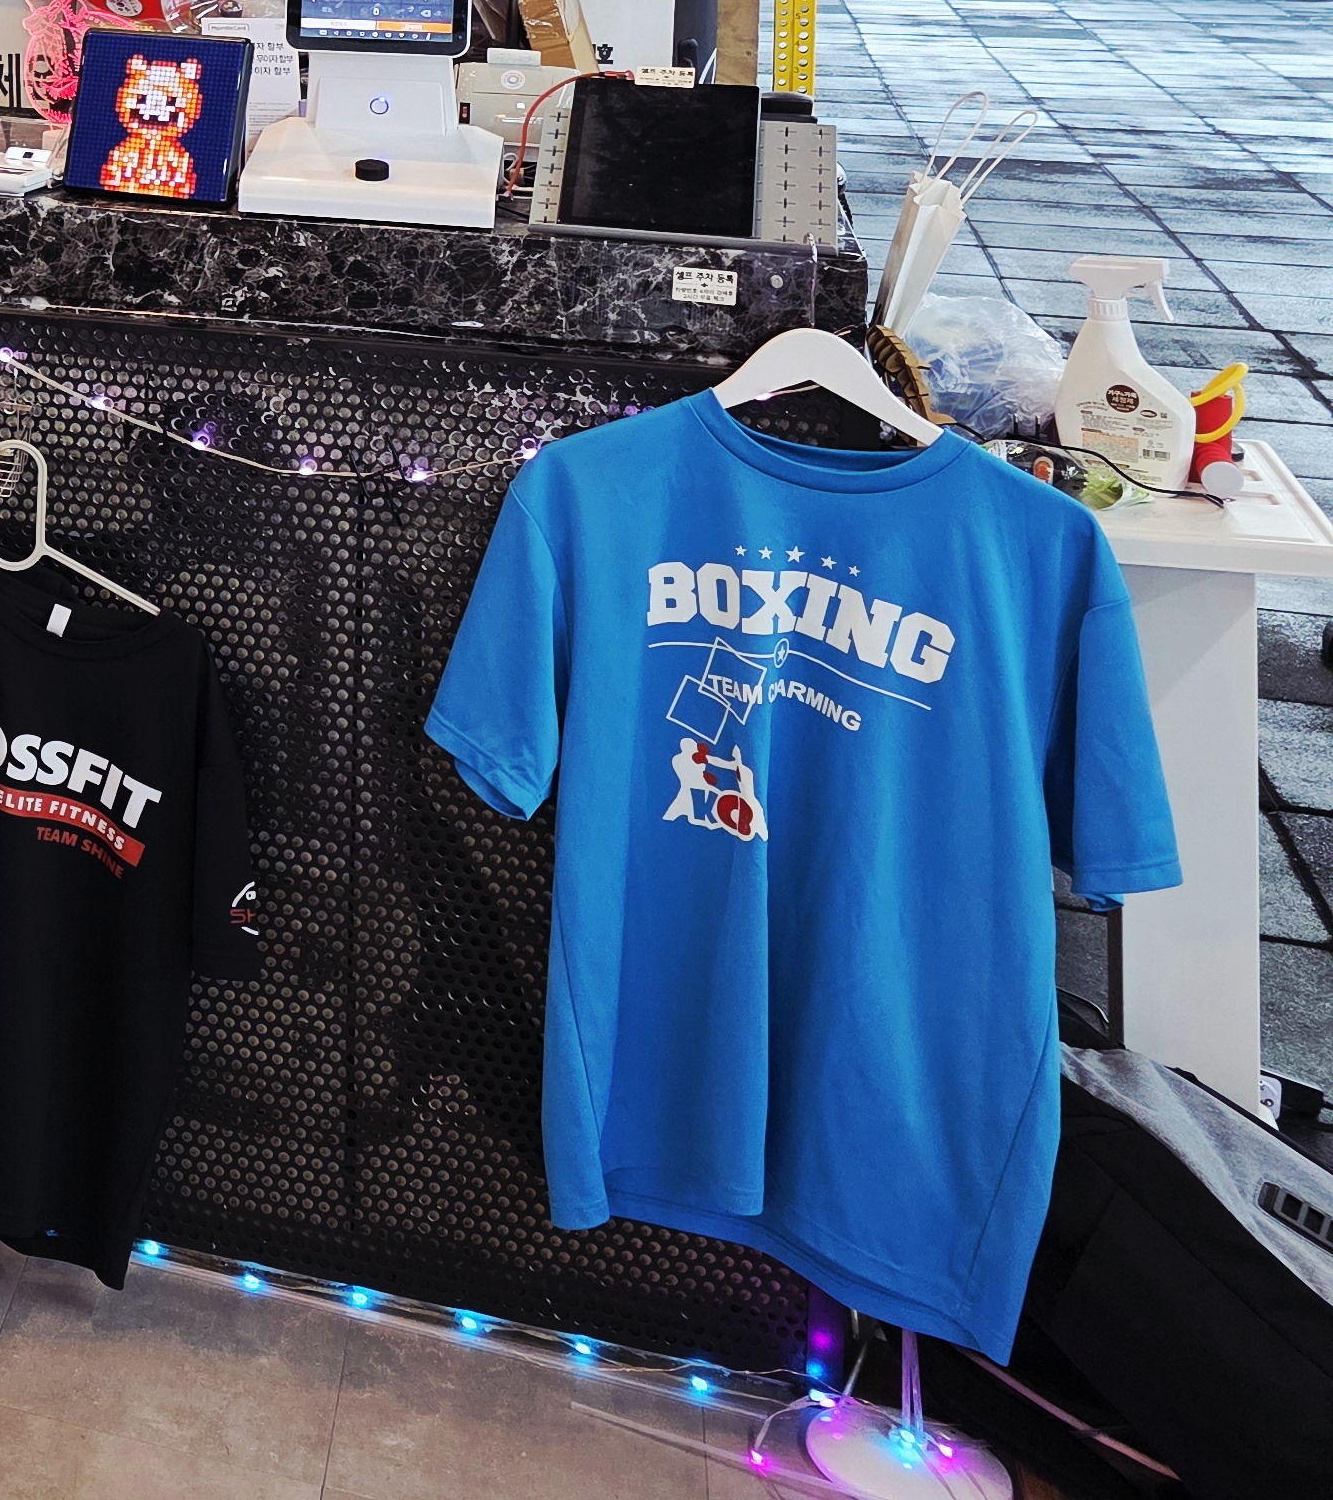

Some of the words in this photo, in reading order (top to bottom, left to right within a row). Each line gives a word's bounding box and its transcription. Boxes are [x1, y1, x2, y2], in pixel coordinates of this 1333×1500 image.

[695, 272, 714, 283] 주차
[717, 273, 734, 284] 등록
[646, 561, 956, 684] BOXING
[707, 674, 762, 705] TEAM
[49, 800, 125, 852] FITNESS
[37, 825, 77, 846] TEAM
[81, 838, 124, 880] SHINE
